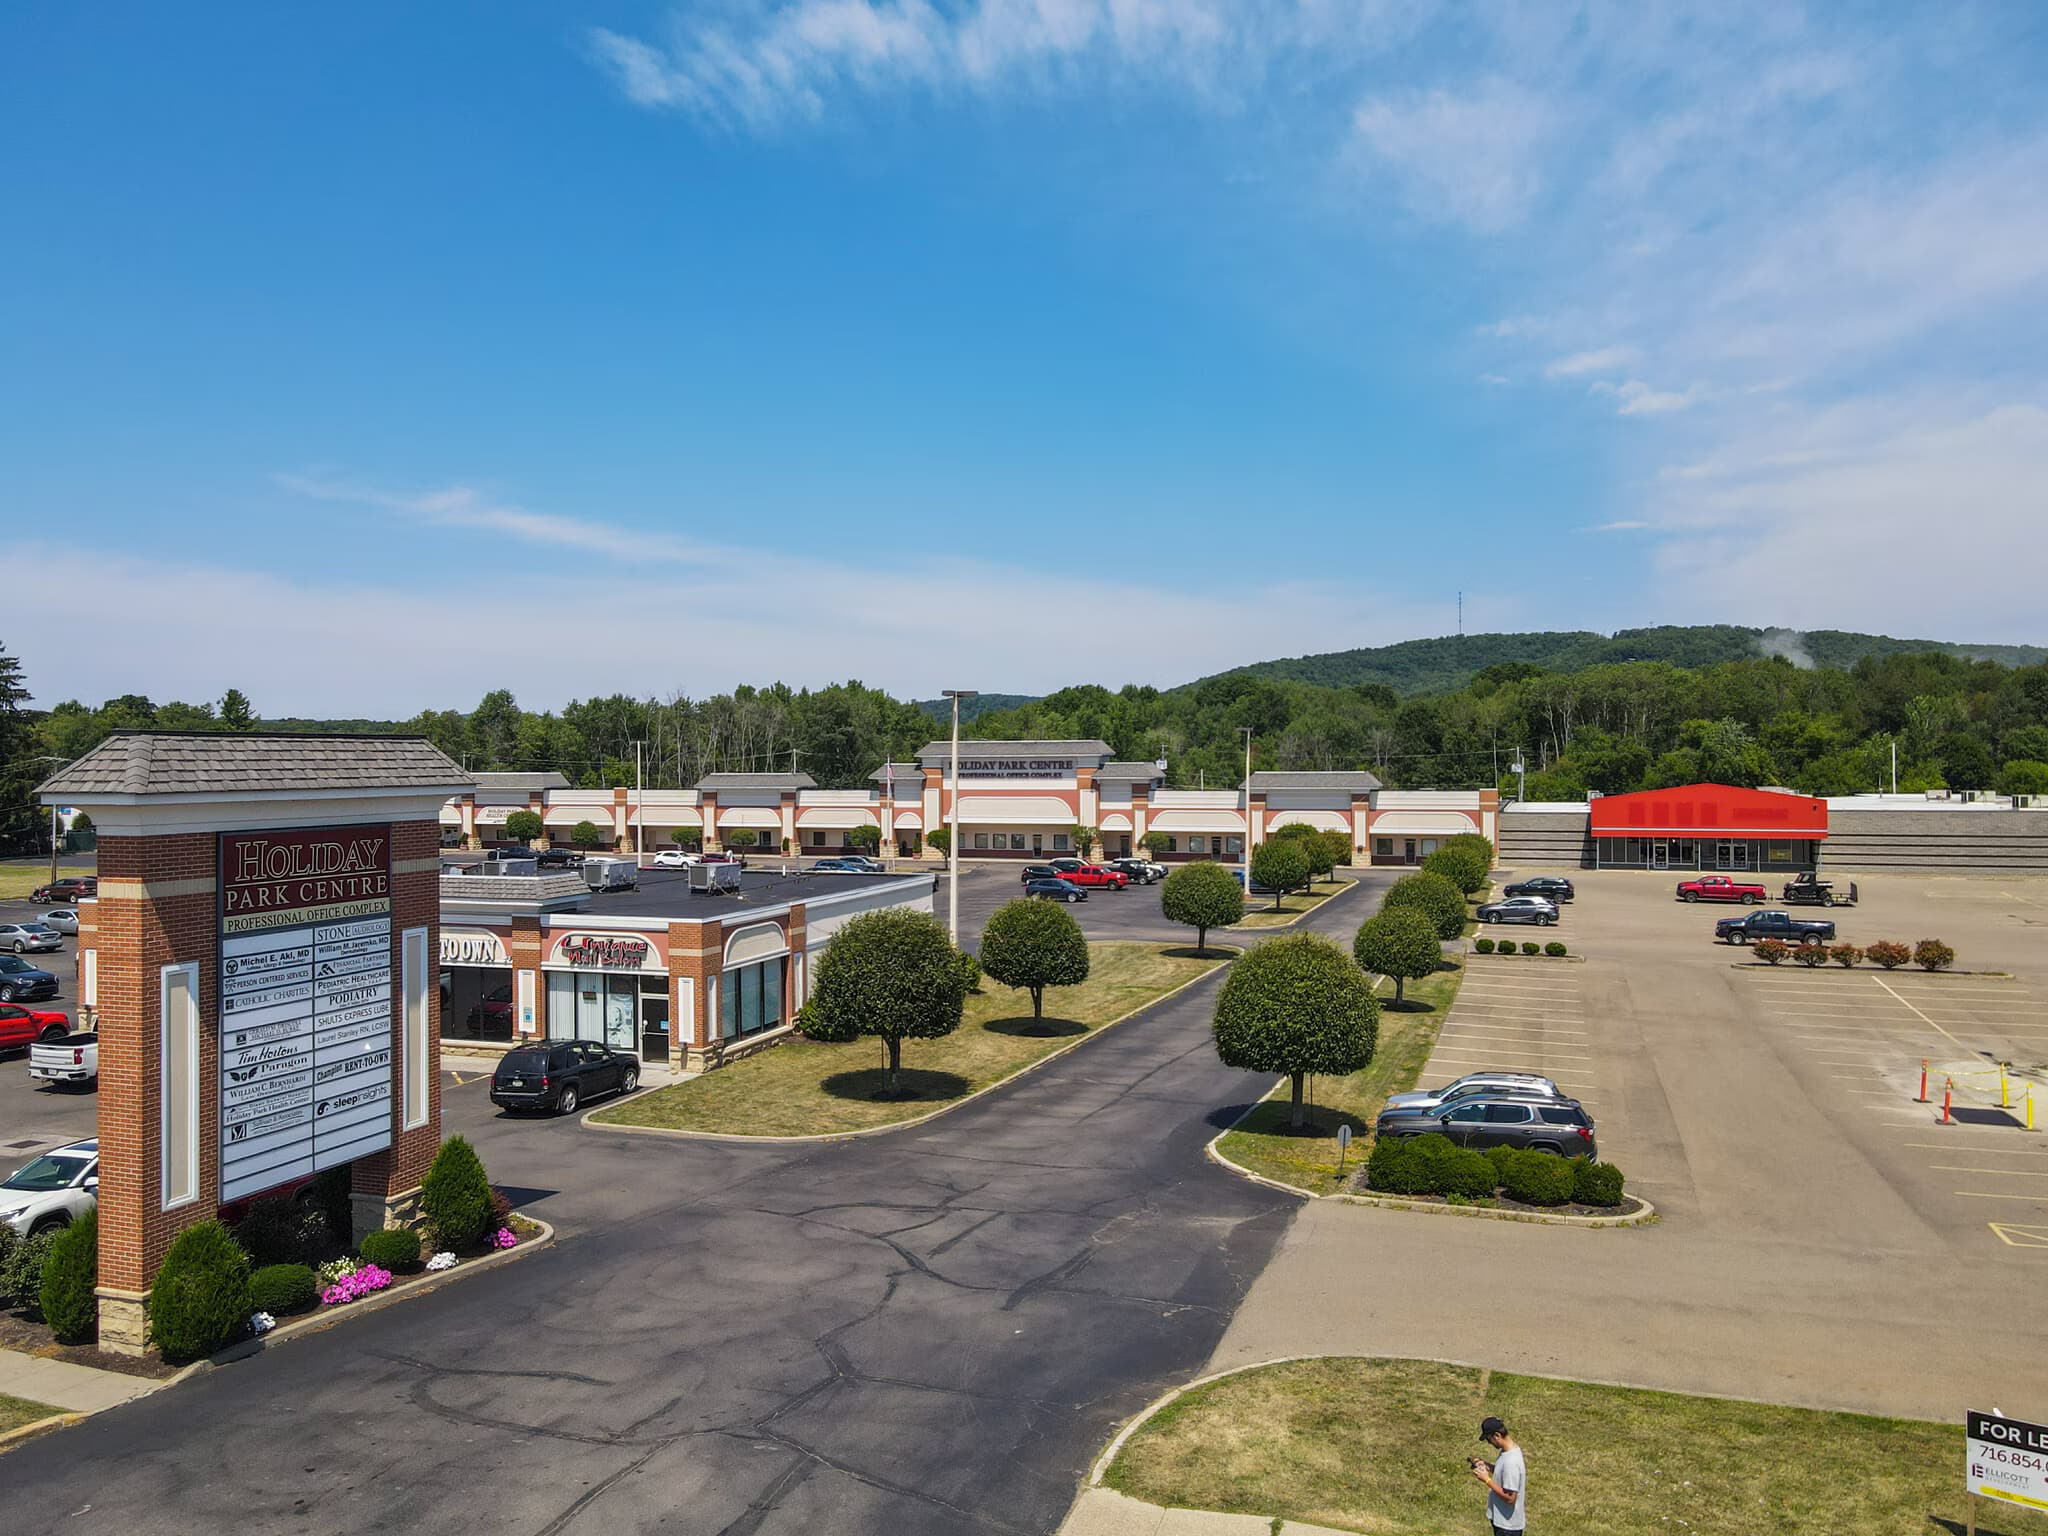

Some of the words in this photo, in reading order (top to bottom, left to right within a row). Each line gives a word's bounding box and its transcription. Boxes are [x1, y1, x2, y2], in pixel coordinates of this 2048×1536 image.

[998, 760, 1026, 770] PARK
[1029, 760, 1073, 770] CENTRE
[234, 839, 384, 882] HOLIDAY
[225, 885, 290, 911] PARK
[299, 875, 388, 902] CENTRE
[228, 911, 305, 931] PROFESSIONAL
[307, 906, 341, 920] OFFICE
[342, 901, 387, 916] COMPLEX
[318, 925, 352, 941] STONE
[240, 955, 268, 967] Michel
[270, 954, 278, 962] E.
[297, 949, 310, 958] MD
[318, 944, 342, 954] William
[462, 939, 497, 961] OWN
[560, 937, 648, 959] Unique
[237, 978, 258, 988] PERSON
[259, 973, 286, 985] CENTERED
[286, 970, 309, 980] SERVICES
[318, 978, 351, 990] PEDIATRIC
[351, 970, 389, 984] HEALTHCARE
[235, 994, 272, 1008] CATHOLIC
[273, 987, 310, 1001] CHARITIES
[329, 987, 377, 1005] PODIATRY
[318, 1014, 342, 1027] SHULTS
[344, 1008, 373, 1021] EXPRESS
[373, 1003, 389, 1014] LUBE
[317, 1034, 337, 1044] Laurel
[337, 1029, 359, 1039] Stanley
[372, 1022, 389, 1031] LCSW
[238, 1048, 258, 1065] Tim
[258, 1045, 298, 1061] Hortons
[261, 1056, 308, 1073] Paragon
[317, 1064, 343, 1081] Champion
[345, 1052, 389, 1073] RENT-TO-OWN
[230, 1085, 261, 1098] WILLIAM
[333, 1086, 388, 1108] sleepinsights
[226, 1111, 252, 1123] Holiday
[253, 1107, 268, 1117] Park
[1980, 1420, 2021, 1444] FOR
[2028, 1431, 2048, 1449] LE
[1985, 1467, 2030, 1483] ELLICOTT
